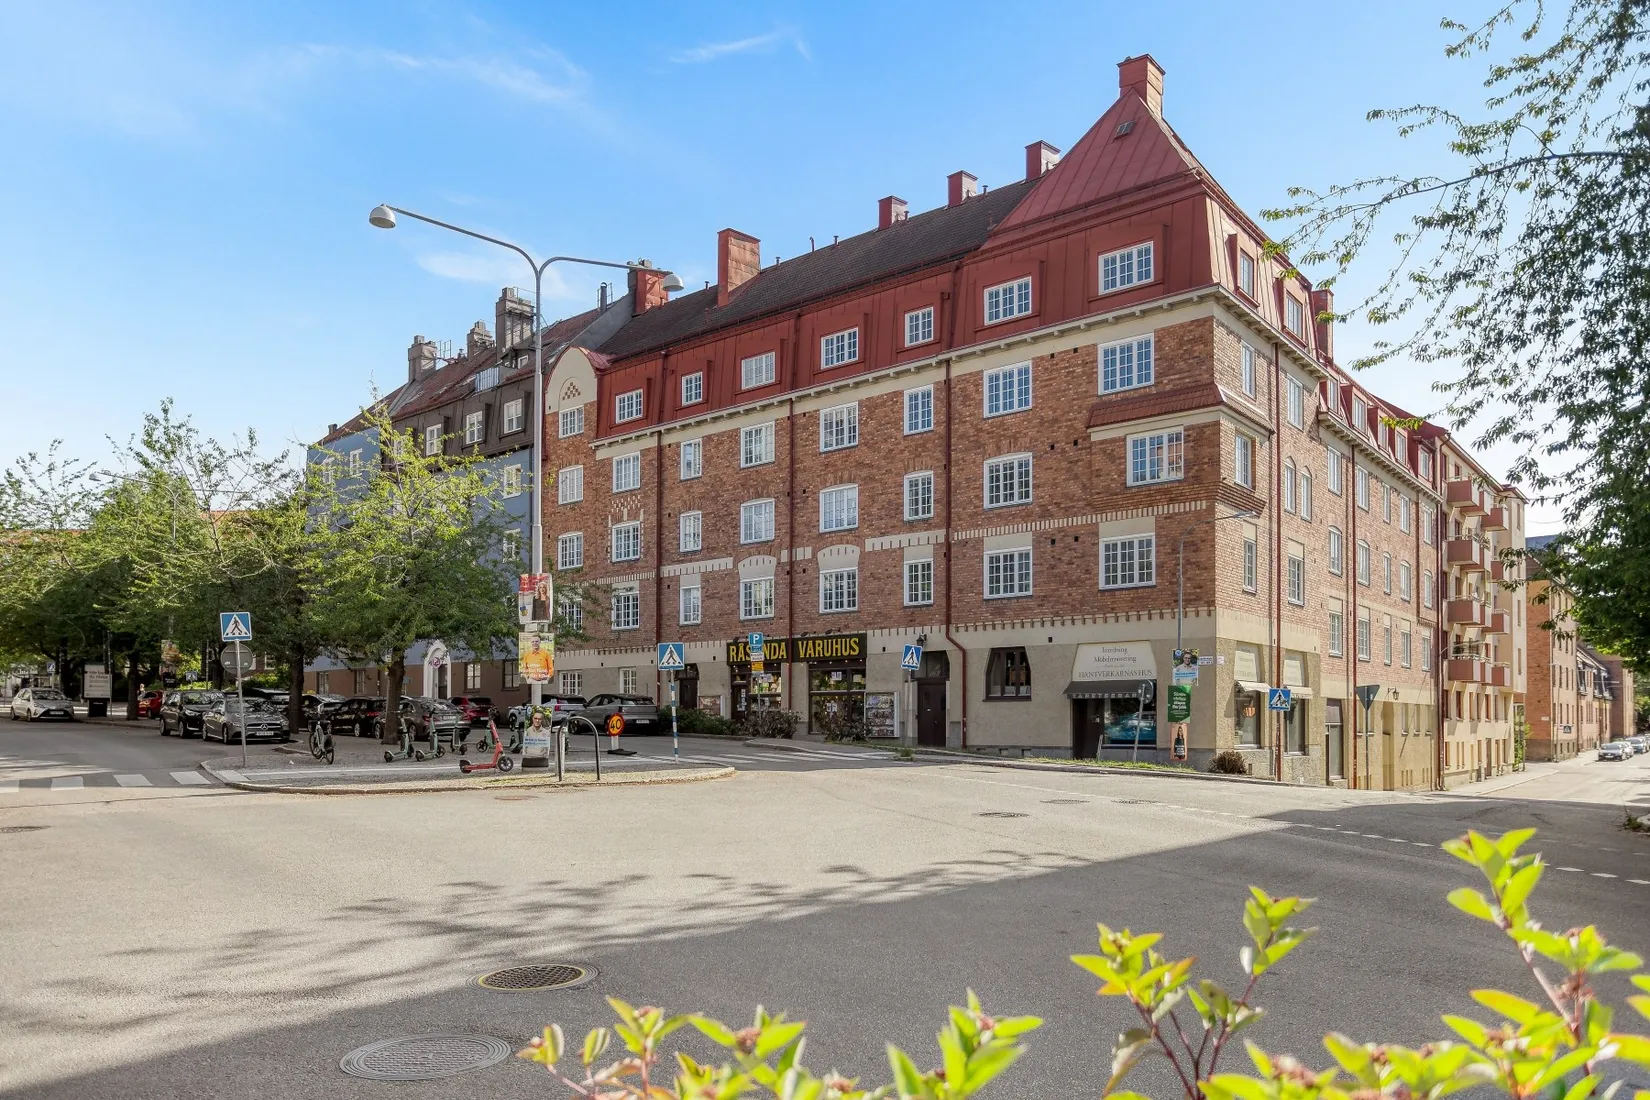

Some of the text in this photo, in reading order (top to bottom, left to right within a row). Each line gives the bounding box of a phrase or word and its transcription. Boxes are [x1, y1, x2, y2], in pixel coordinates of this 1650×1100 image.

[753, 634, 760, 644] P
[729, 642, 787, 662] RÅSNDA
[798, 638, 860, 658] VARUHUS
[610, 719, 621, 730] 40
